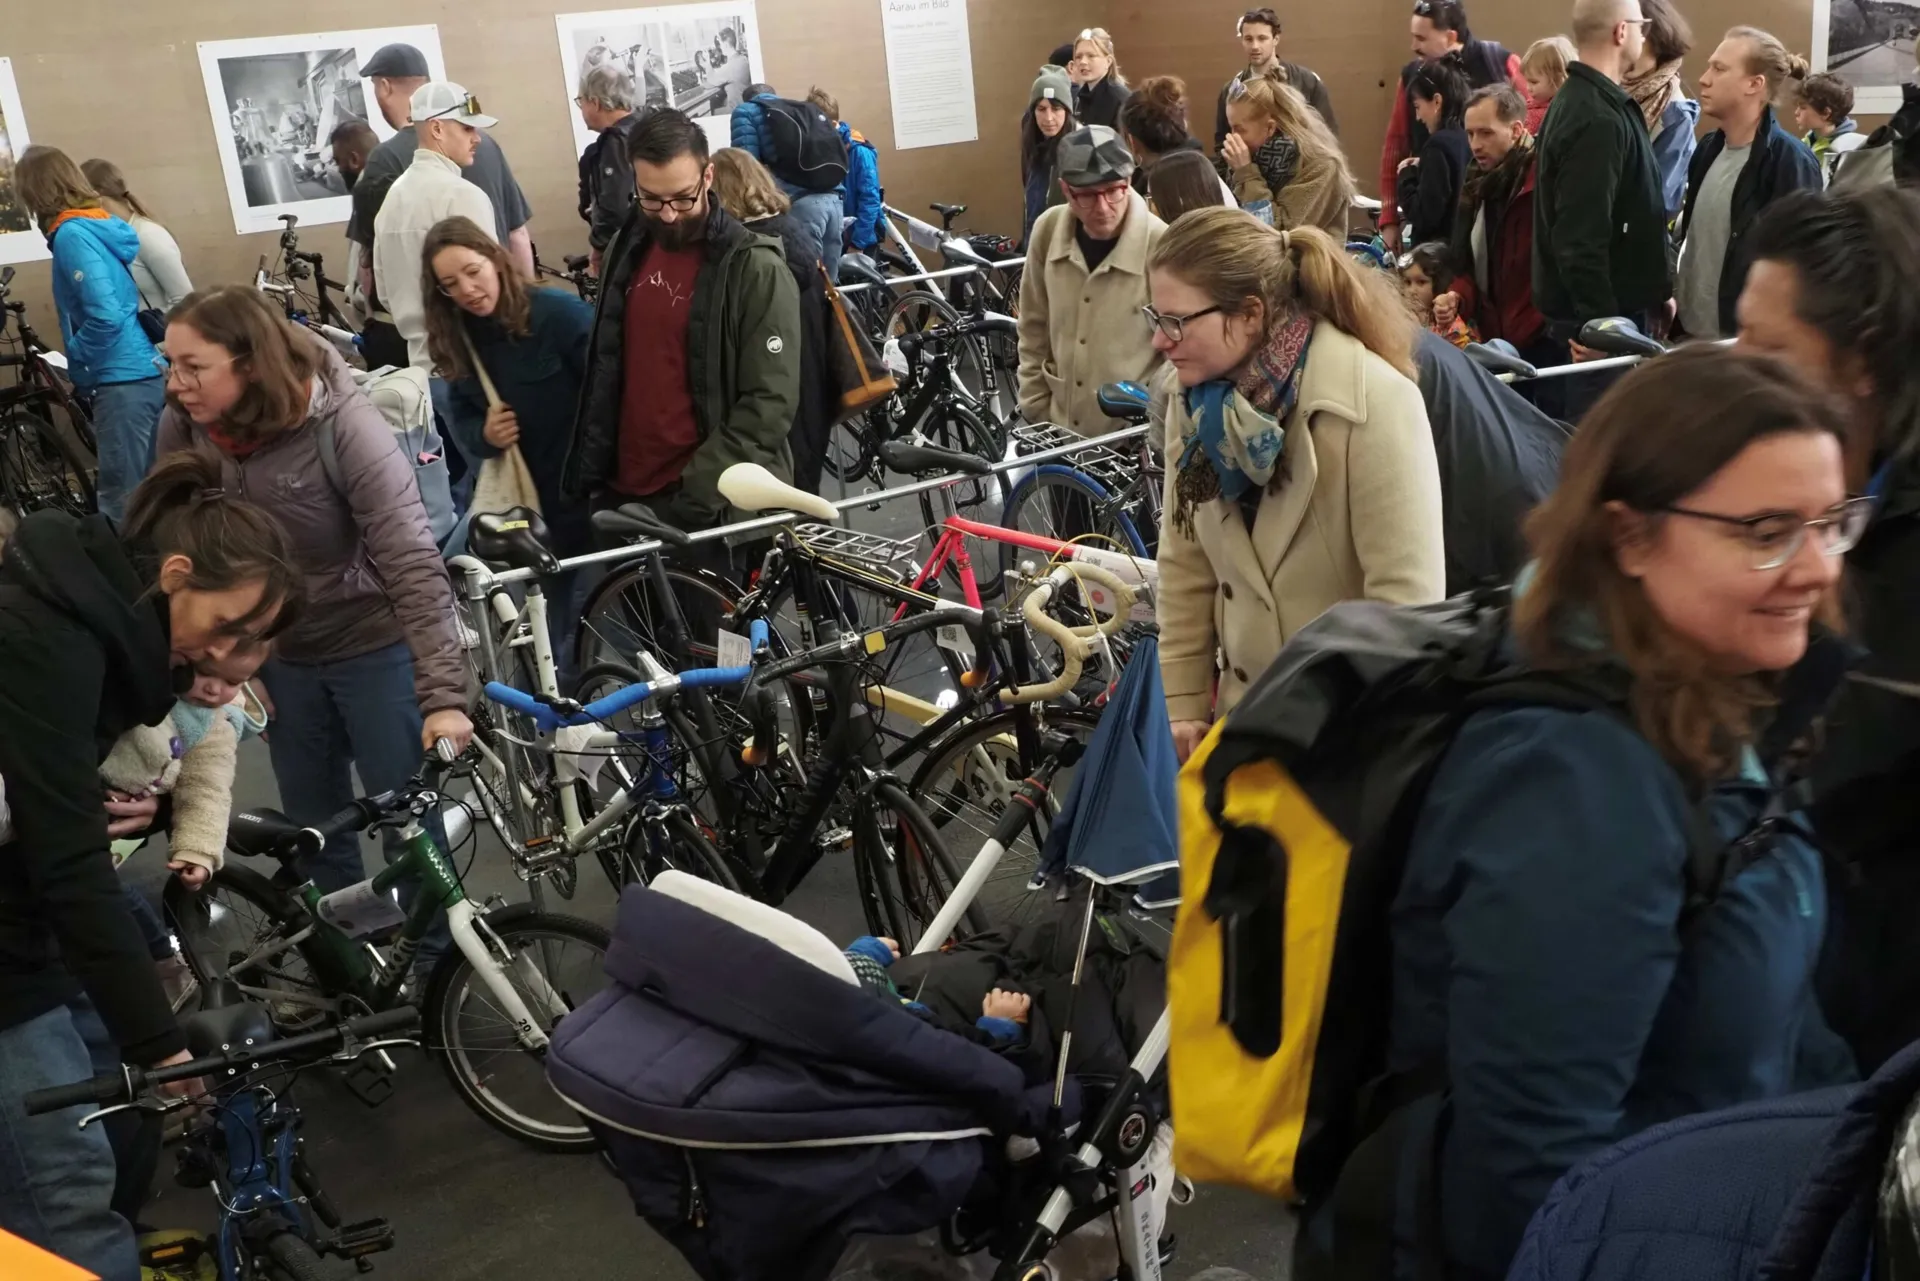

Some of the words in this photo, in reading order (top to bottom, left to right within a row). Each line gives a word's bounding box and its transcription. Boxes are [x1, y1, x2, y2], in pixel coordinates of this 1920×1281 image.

[889, 2, 916, 12] Aarau
[919, 1, 930, 9] im
[932, 0, 950, 10] Bild
[896, 242, 923, 275] GIANT
[980, 335, 994, 389] FOCUS
[238, 812, 263, 824] woom
[518, 1018, 531, 1032] 20
